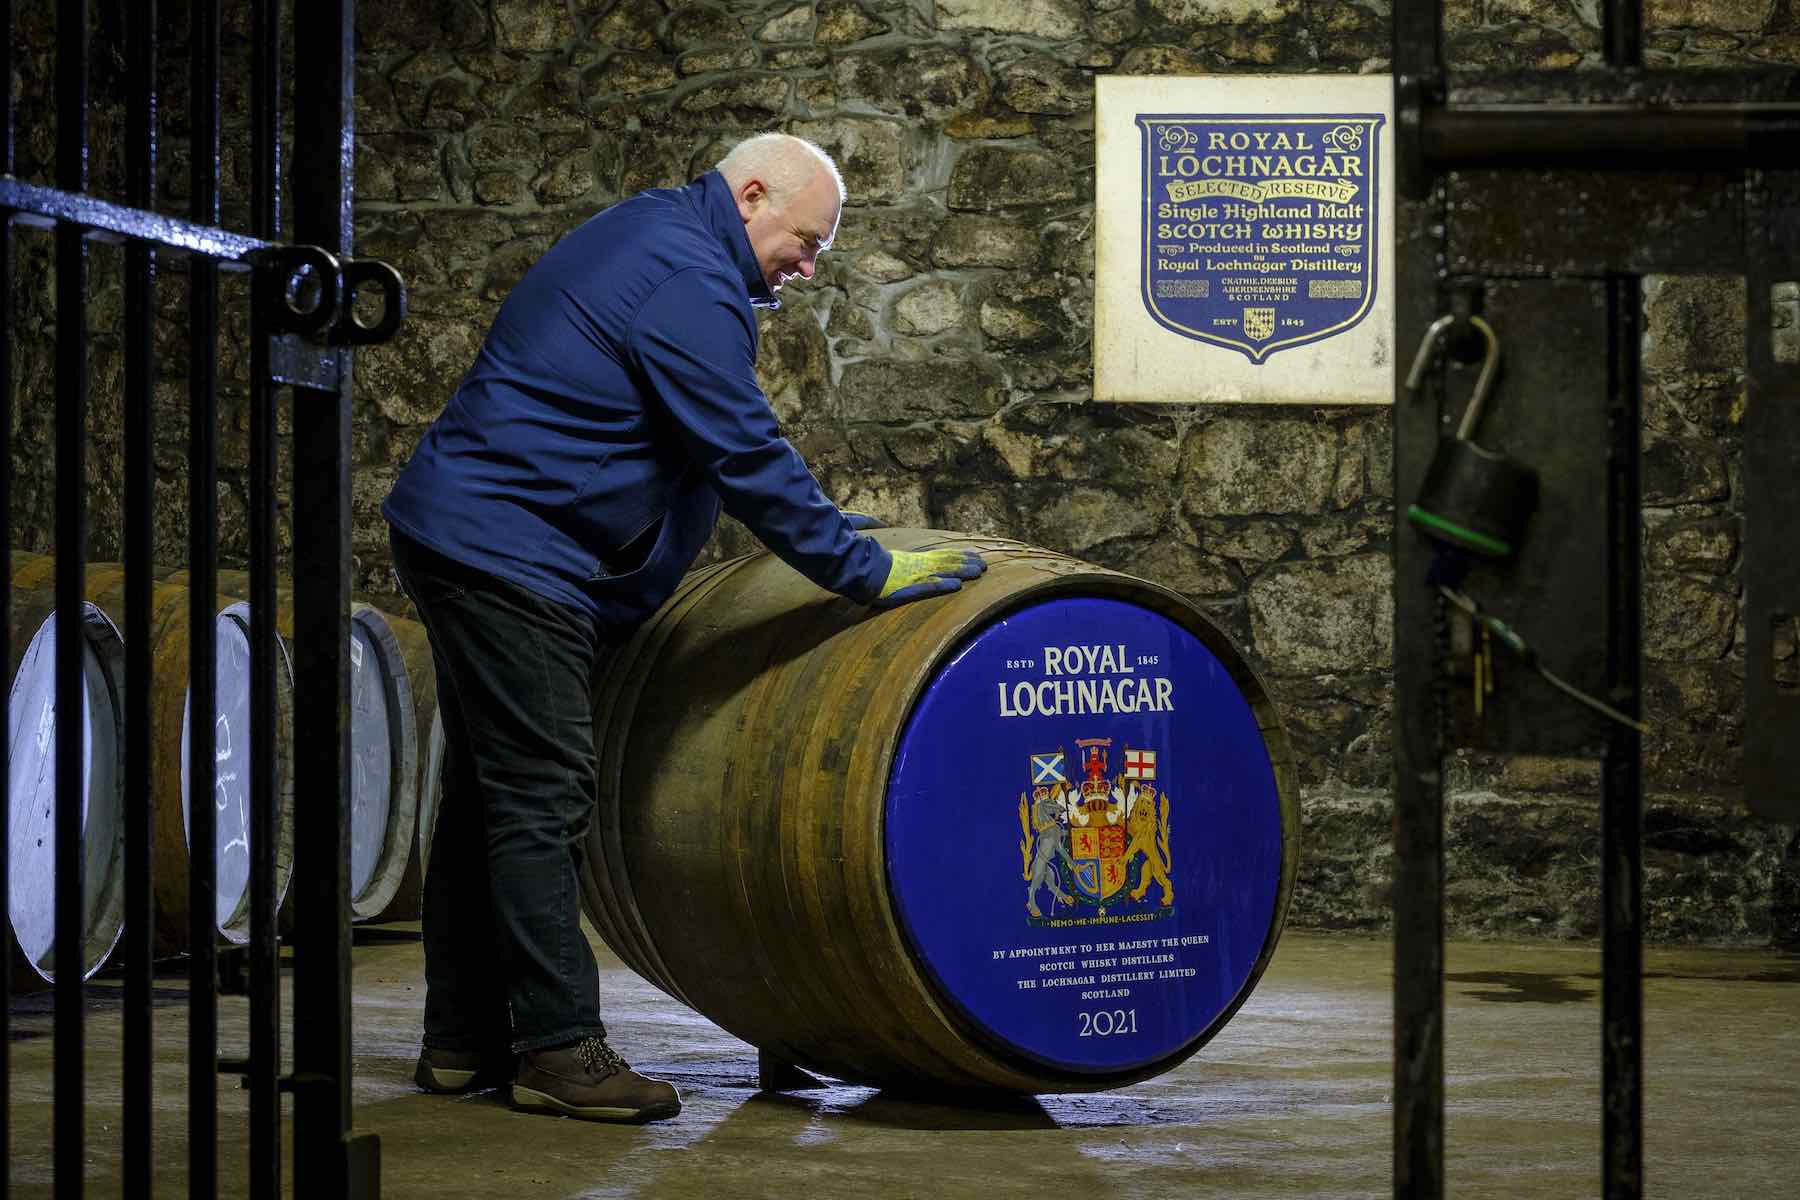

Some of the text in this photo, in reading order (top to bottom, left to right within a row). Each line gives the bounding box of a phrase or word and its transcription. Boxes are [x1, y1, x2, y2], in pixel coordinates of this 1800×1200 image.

[1208, 133, 1313, 150] ROYAL
[1158, 156, 1363, 177] LOCHNAGAR
[1174, 182, 1348, 201] SELECTED RESERVE
[1158, 204, 1364, 221] Single Highland Malt
[1158, 224, 1251, 240] SCOTCH
[1189, 243, 1330, 254] Produced in Scotland
[1158, 259, 1362, 273] Royal Lochnagar Distillery
[1281, 319, 1305, 327] 1845
[1006, 659, 1035, 669] ESTD
[1044, 644, 1134, 676] ROYAL
[1137, 655, 1159, 665] 1845
[998, 677, 1175, 718] LOCHNAGAR
[992, 935, 1209, 960] BY APPOINTMENT TO HER MAJESTY THE QUEEN
[1039, 954, 1175, 972] SCOTCH WHISKY DISTILLERS
[1017, 968, 1196, 989] THE LOCHNAGAR DISTILLERY LIMITED
[1081, 988, 1130, 1000] SCOTLAND
[1078, 1008, 1138, 1037] 2021
